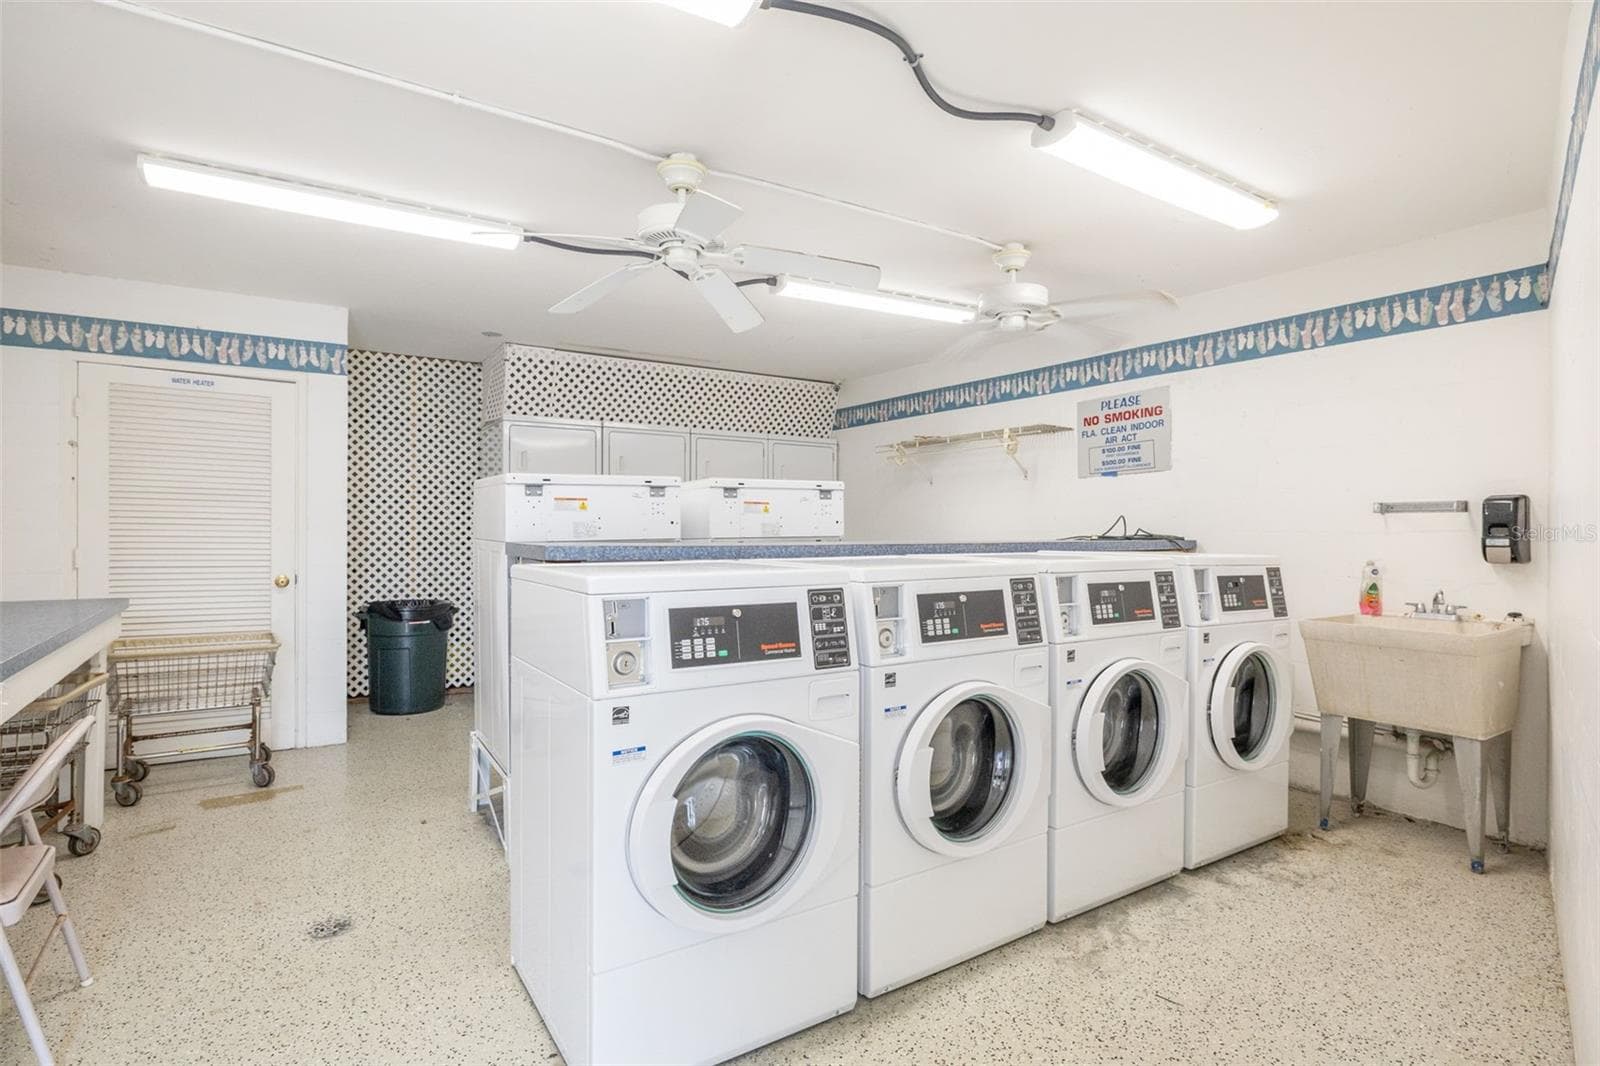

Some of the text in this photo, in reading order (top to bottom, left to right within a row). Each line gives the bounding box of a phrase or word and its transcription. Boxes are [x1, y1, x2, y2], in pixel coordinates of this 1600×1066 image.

[1100, 394, 1142, 411] PLEASE
[1083, 405, 1163, 427] NO SMOKING
[1081, 418, 1165, 438] FLA. CLEAN INDOOR
[1104, 433, 1137, 445] AIR ACT
[1101, 445, 1126, 454] $100.00
[1127, 443, 1142, 451] FINE
[1101, 457, 1126, 466] $500.00
